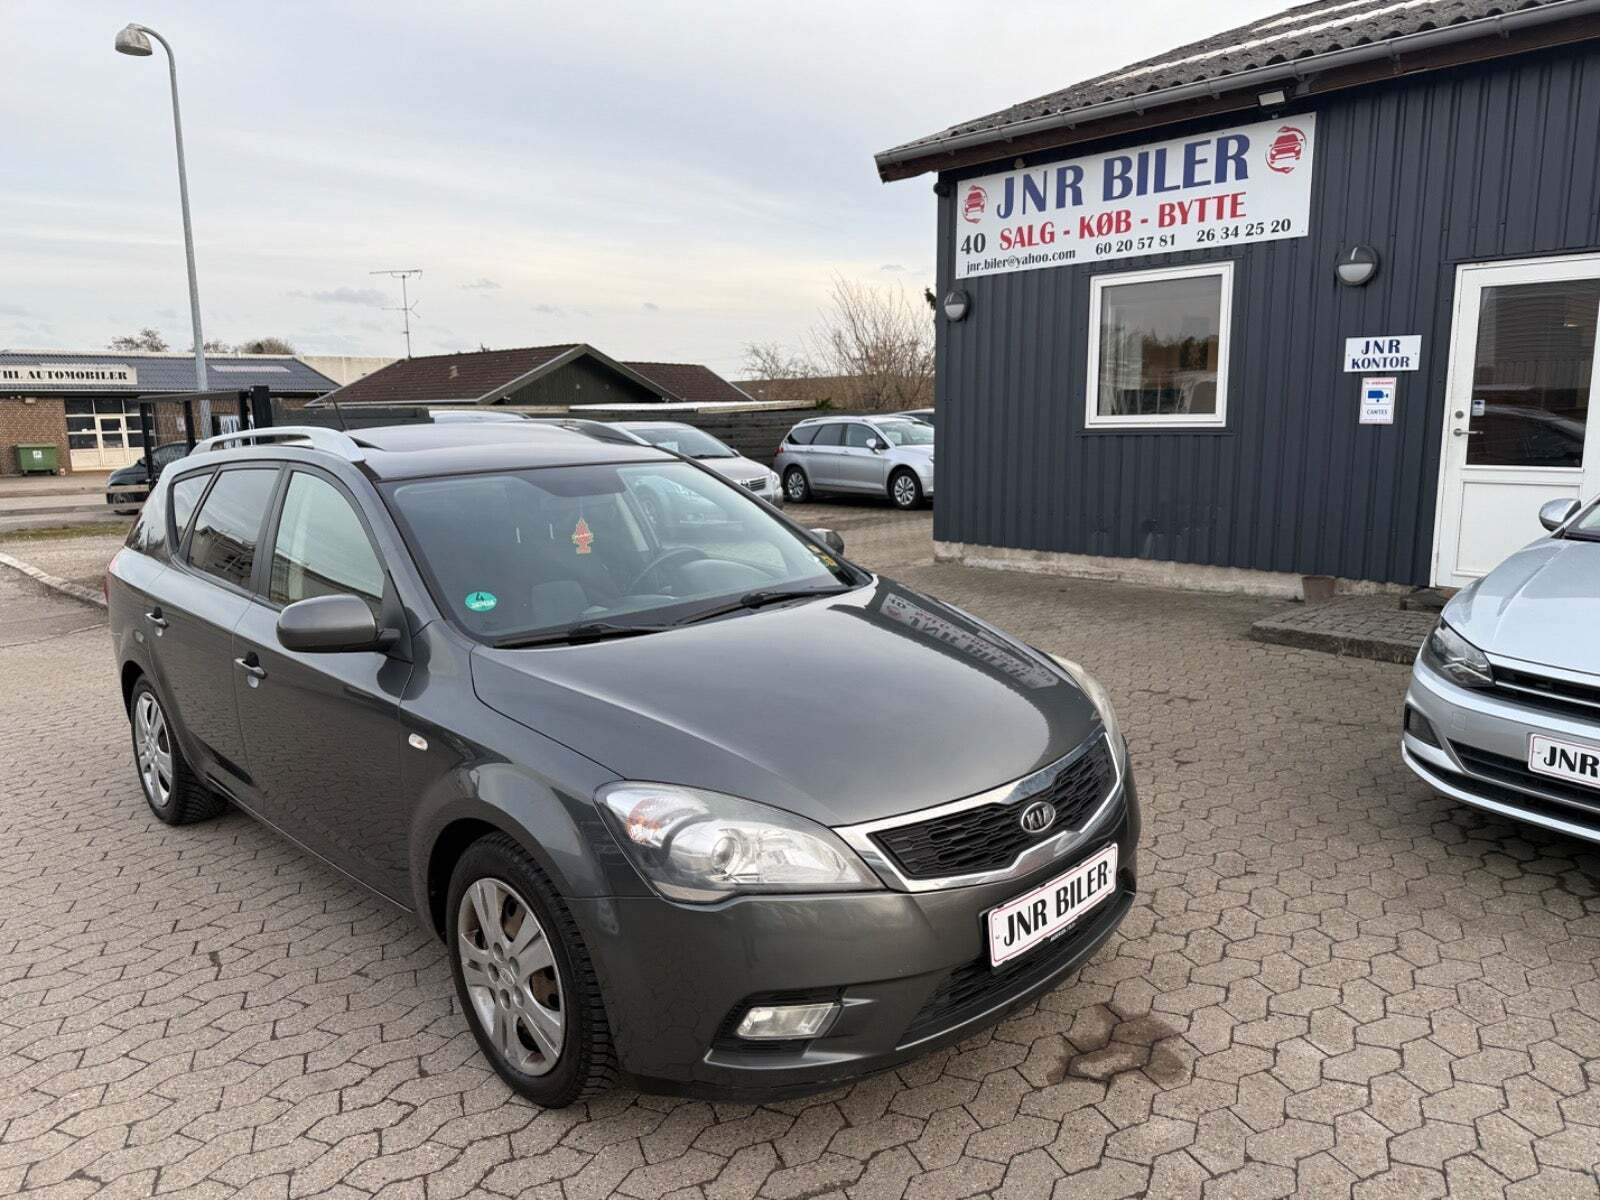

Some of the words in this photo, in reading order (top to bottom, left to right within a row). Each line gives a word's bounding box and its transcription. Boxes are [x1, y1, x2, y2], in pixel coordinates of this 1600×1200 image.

[996, 165, 1084, 219] JNR
[1102, 134, 1250, 202] BILER
[999, 221, 1056, 251] SALG
[1079, 209, 1132, 240] KØB
[1158, 192, 1247, 229] BYTTE
[960, 232, 986, 255] 40
[1095, 242, 1112, 255] 60
[1115, 239, 1134, 253] 20
[1137, 236, 1155, 250] 57
[1159, 233, 1176, 247] 81
[1196, 229, 1216, 243] 26
[1220, 225, 1239, 240] 34
[1245, 222, 1265, 237] 25
[1271, 218, 1291, 234] 20
[966, 249, 1076, 274] jnr.biler@yahoo.com
[1361, 339, 1400, 355] JNR
[26, 370, 128, 381] AUTOMOBILER
[1351, 356, 1410, 369] KONTOR
[1543, 745, 1599, 778] JNR
[1004, 898, 1048, 946] JNR
[1055, 860, 1108, 919] BILER
